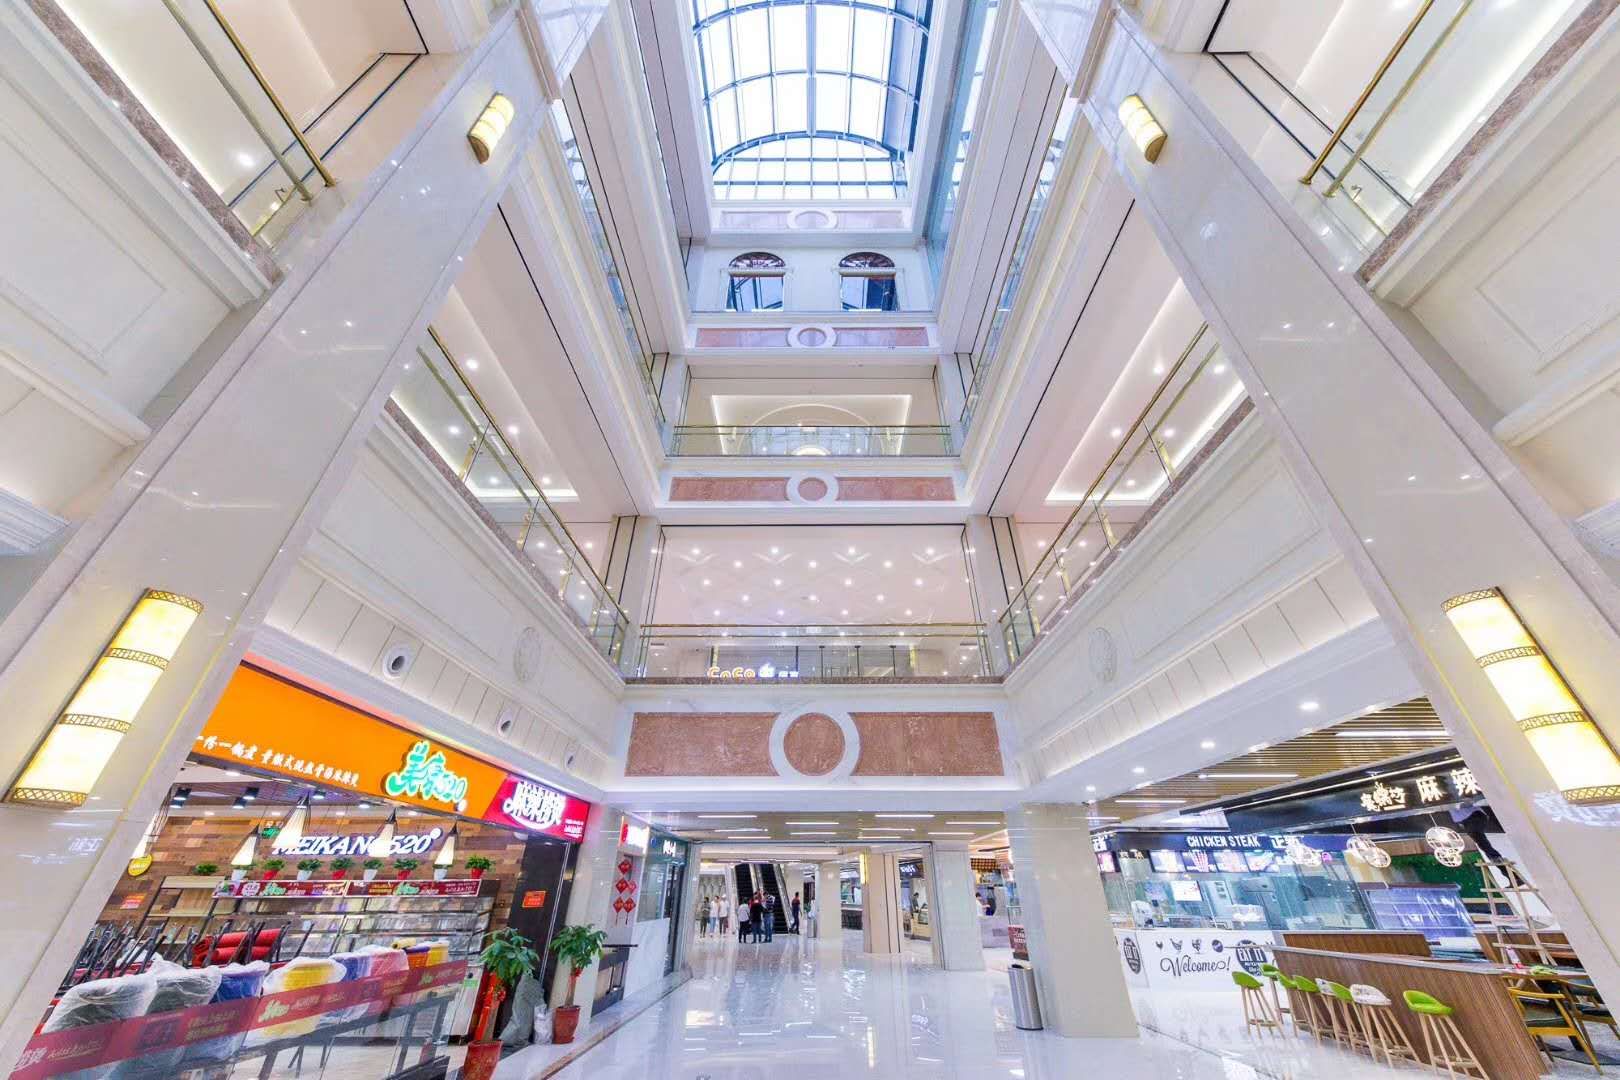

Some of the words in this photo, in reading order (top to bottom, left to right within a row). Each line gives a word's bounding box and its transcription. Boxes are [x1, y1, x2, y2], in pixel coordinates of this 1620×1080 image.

[1186, 834, 1227, 848] CHICKEN
[1229, 835, 1260, 848] STEAK
[1237, 948, 1253, 962] EAT
[1160, 954, 1231, 977] Welcome!
